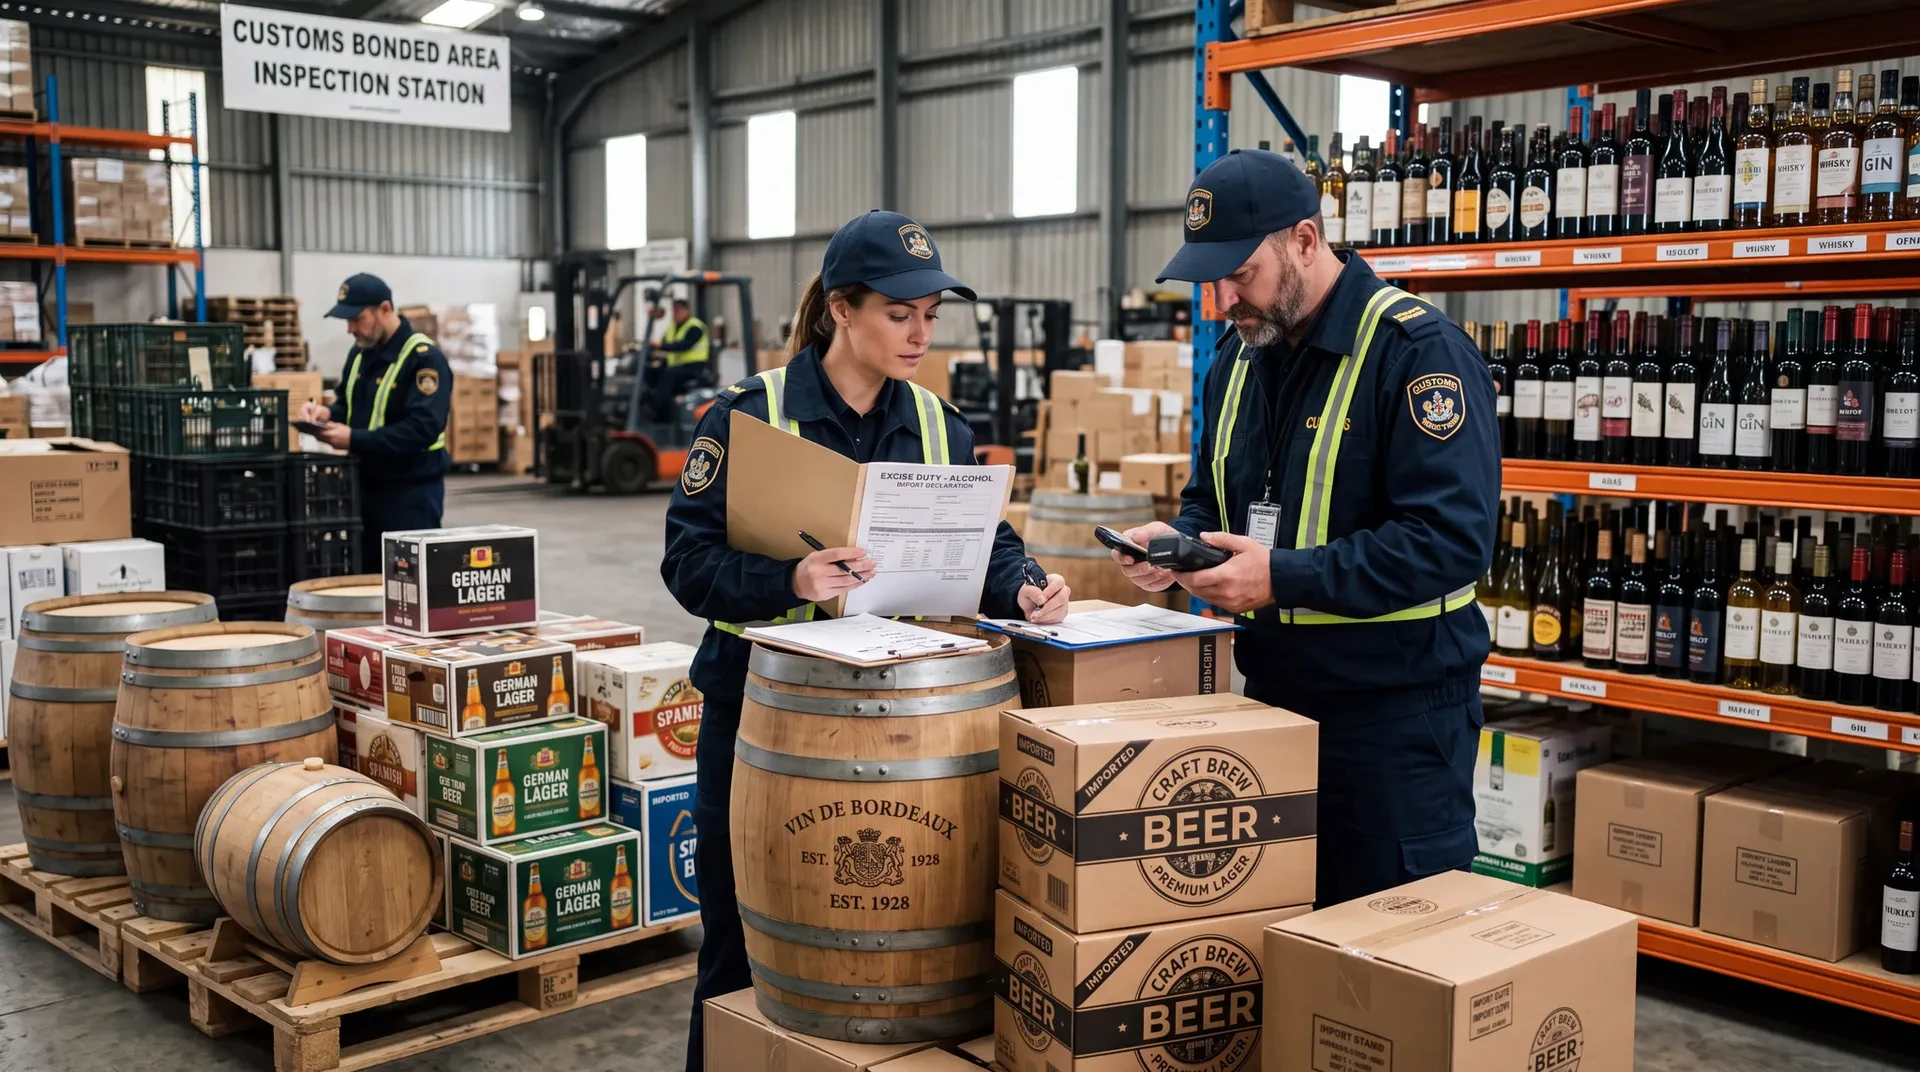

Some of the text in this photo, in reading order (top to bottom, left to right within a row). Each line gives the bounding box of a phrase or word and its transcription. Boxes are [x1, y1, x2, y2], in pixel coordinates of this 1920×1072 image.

[233, 19, 501, 71] CUSTOMS BONDED AREA
[254, 60, 485, 105] INSPECTION STATION
[1864, 156, 1893, 172] GIN
[1818, 240, 1855, 250] WHISKY
[880, 472, 914, 481] EXCISE
[916, 473, 942, 482] DUTY
[949, 475, 994, 483] ALCOHOL
[896, 481, 924, 489] IMPORT
[451, 567, 512, 588] GERMAN
[457, 584, 506, 604] LAGER
[492, 674, 538, 693] GERMAN
[496, 688, 535, 708] LAGER
[1017, 735, 1054, 763] IMPORTED
[523, 767, 569, 787] GERMAN
[1084, 746, 1136, 798] IMPORTED
[1152, 757, 1254, 802] CRAFT BREW
[442, 786, 462, 806] BEER
[524, 781, 568, 805] LAGER
[784, 799, 959, 841] VIN DE BORDEAUX
[1012, 791, 1057, 841] BEER
[1143, 805, 1259, 851] BEER
[801, 850, 940, 867] EST. 1928
[1152, 854, 1250, 897] PREMIUM LAGER
[555, 878, 601, 900] GERMAN
[829, 893, 910, 911] EST. 1928
[556, 892, 601, 917] LAGER
[1085, 939, 1135, 990] IMPORTED
[1151, 944, 1252, 993] CRAFT BREW
[1009, 973, 1056, 1032] BEER
[1142, 989, 1256, 1041] BEER
[1536, 1013, 1578, 1047] CRAFT BREW
[1534, 1038, 1578, 1072] BEER
